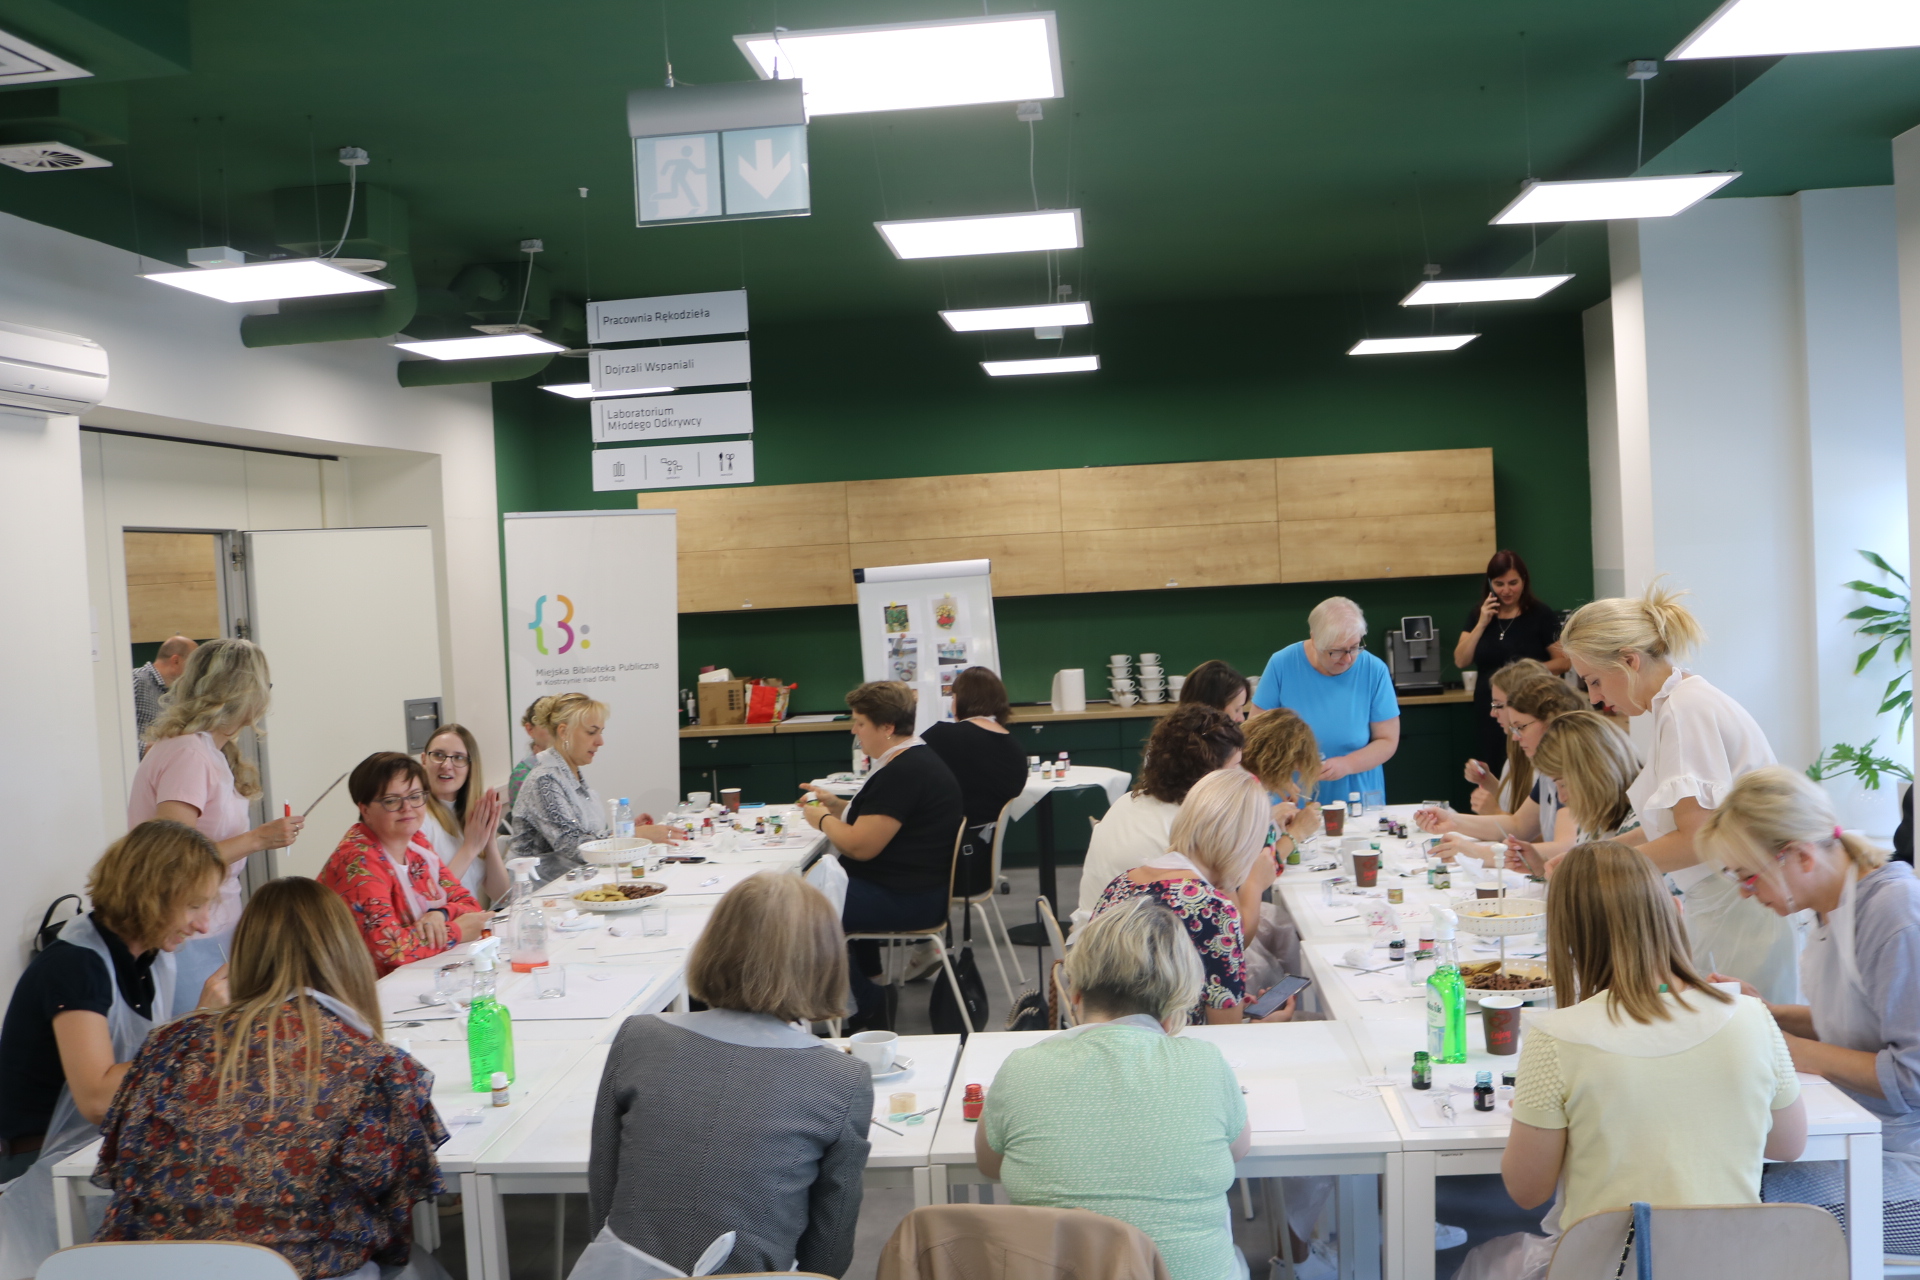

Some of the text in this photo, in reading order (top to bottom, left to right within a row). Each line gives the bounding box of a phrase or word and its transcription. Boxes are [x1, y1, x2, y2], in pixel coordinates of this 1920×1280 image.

[603, 309, 710, 325] Pracownia Rękodzieła
[605, 359, 695, 375] Dojrzali Wspaniali
[607, 407, 674, 420] Laboratorium
[608, 418, 702, 431] Młodego Odkrywcy
[536, 662, 660, 678] Miejska Biblioteka Publiczna
[583, 675, 597, 683] nad
